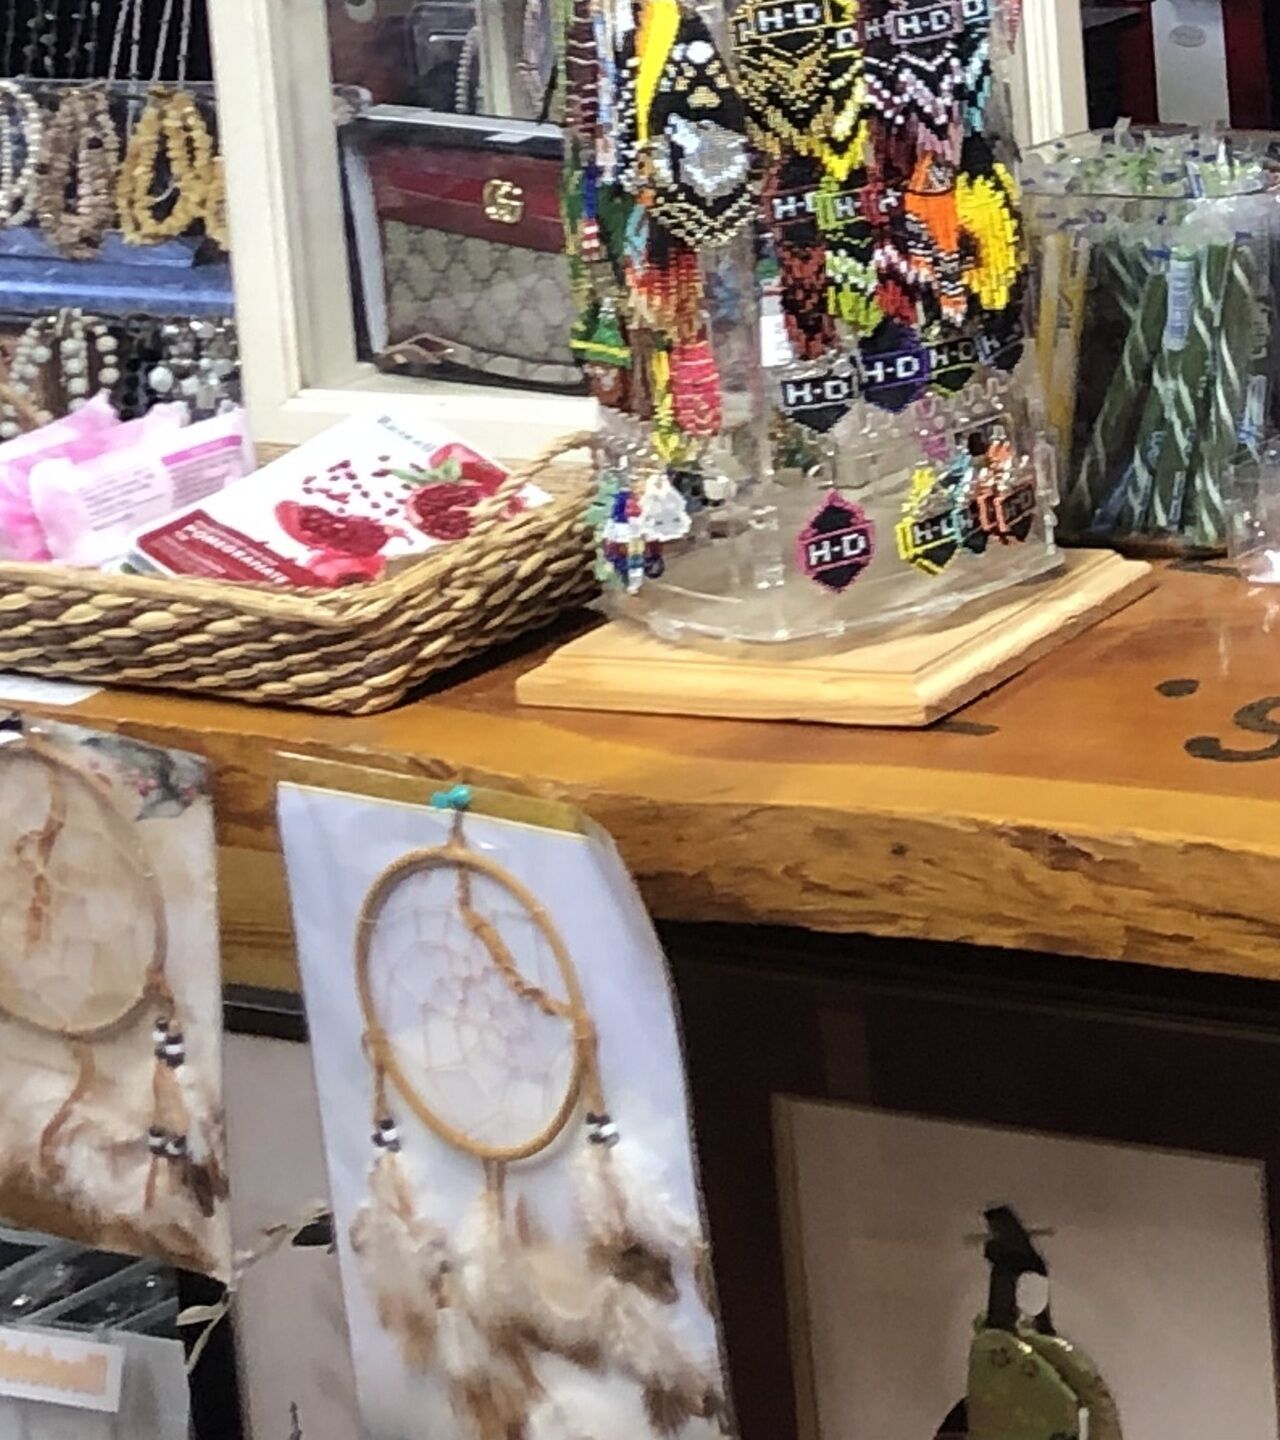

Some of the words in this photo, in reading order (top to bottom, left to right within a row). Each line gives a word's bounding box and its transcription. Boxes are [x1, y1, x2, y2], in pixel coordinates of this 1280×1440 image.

[758, 2, 821, 32] H-D
[898, 8, 952, 37] H-D
[862, 355, 920, 384] H-D
[785, 379, 851, 406] H-D
[808, 531, 868, 566] H-D
